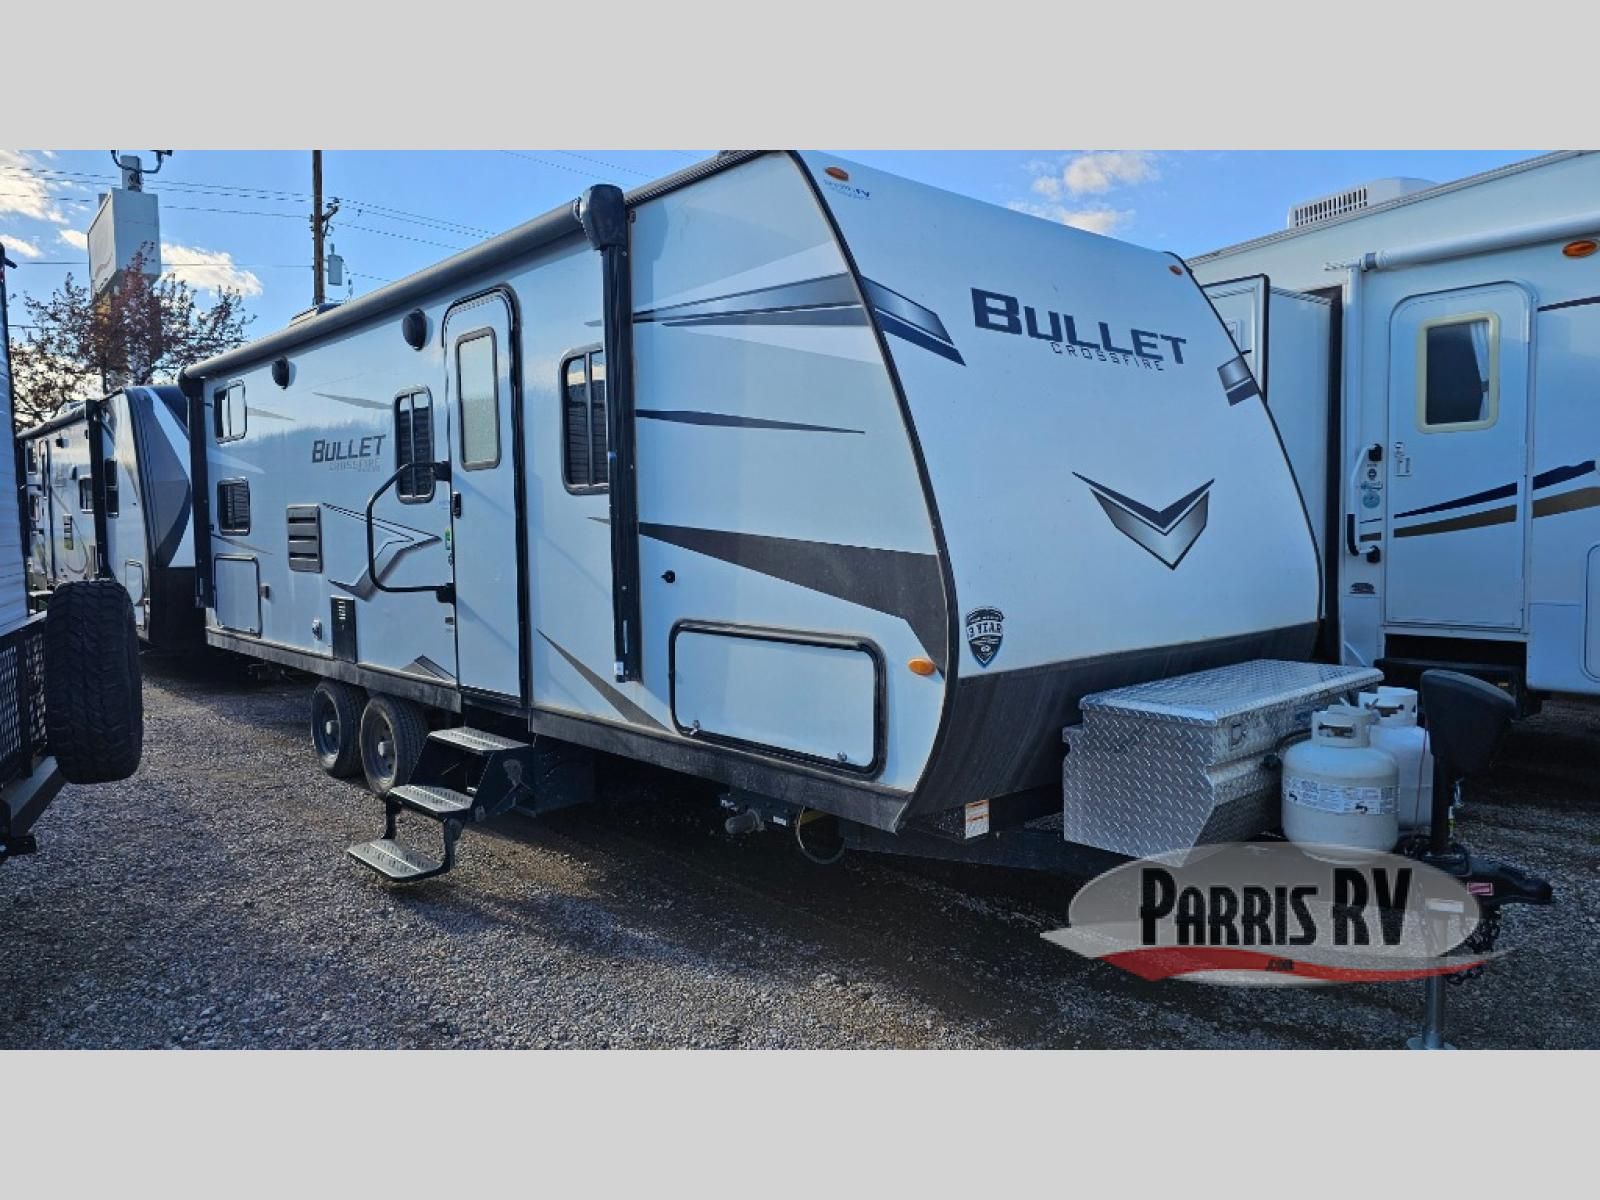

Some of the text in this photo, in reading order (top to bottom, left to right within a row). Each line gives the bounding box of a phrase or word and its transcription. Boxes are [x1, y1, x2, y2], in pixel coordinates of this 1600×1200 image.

[971, 287, 1187, 365] BULLET
[1050, 341, 1164, 371] CROSSFIRE
[312, 434, 386, 463] BULLET
